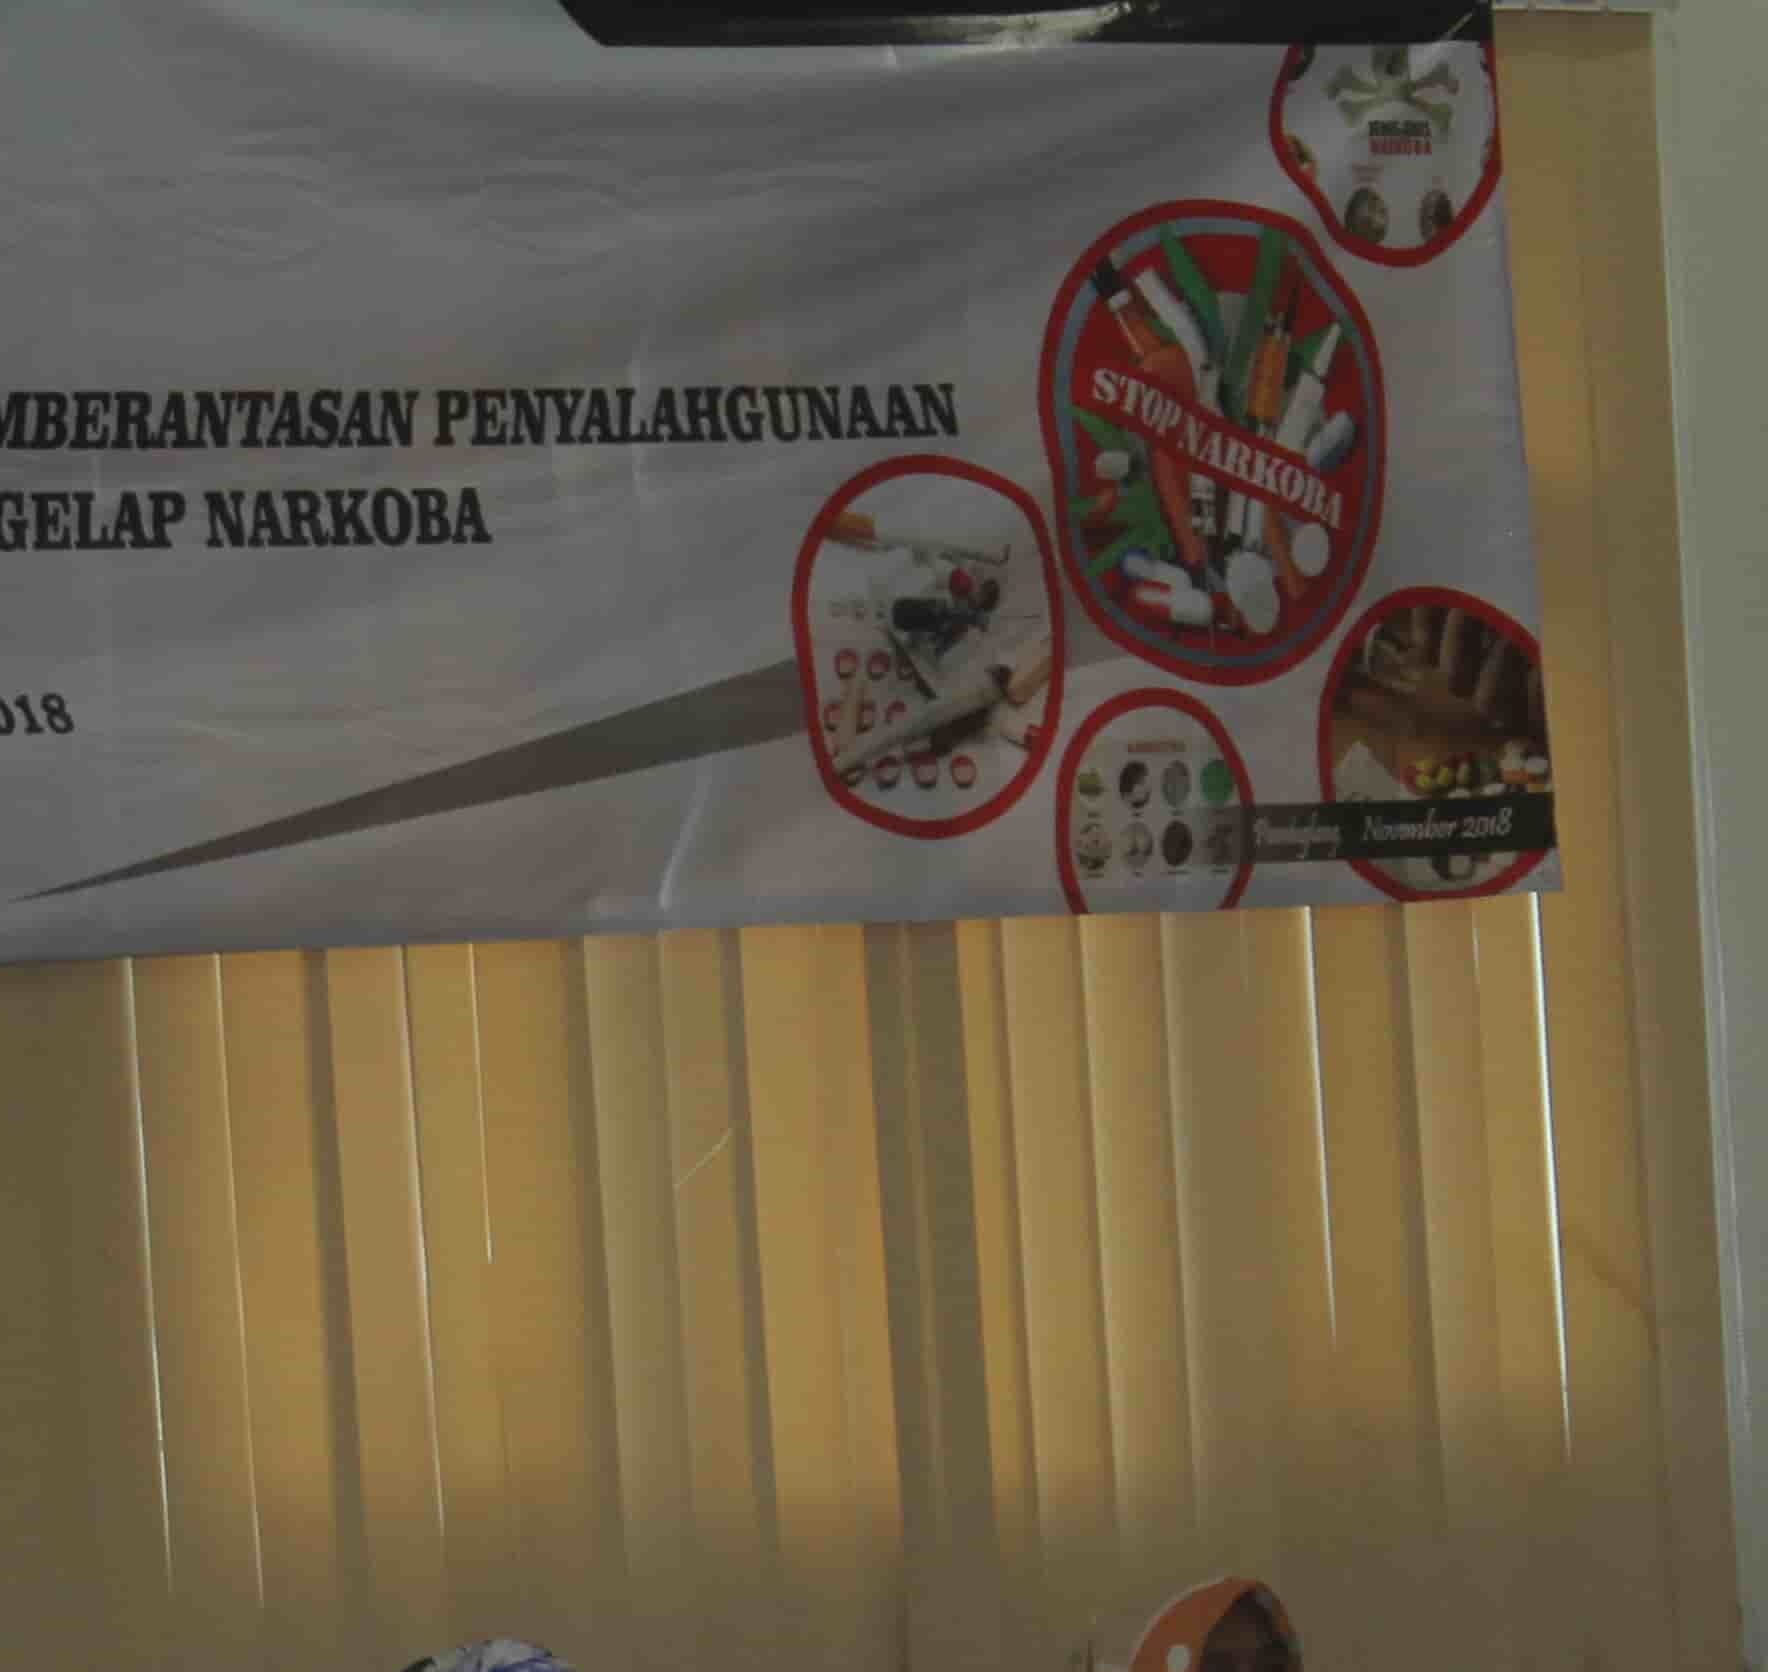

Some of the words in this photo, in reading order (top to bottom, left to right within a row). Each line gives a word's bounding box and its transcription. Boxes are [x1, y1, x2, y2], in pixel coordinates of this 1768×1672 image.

[433, 383, 960, 447] PENYALAHGUNAAN
[1092, 368, 1183, 438] STOP
[1176, 414, 1344, 529] NARKOBA
[204, 487, 493, 548] NARKOBA
[1459, 806, 1515, 838] 2018
